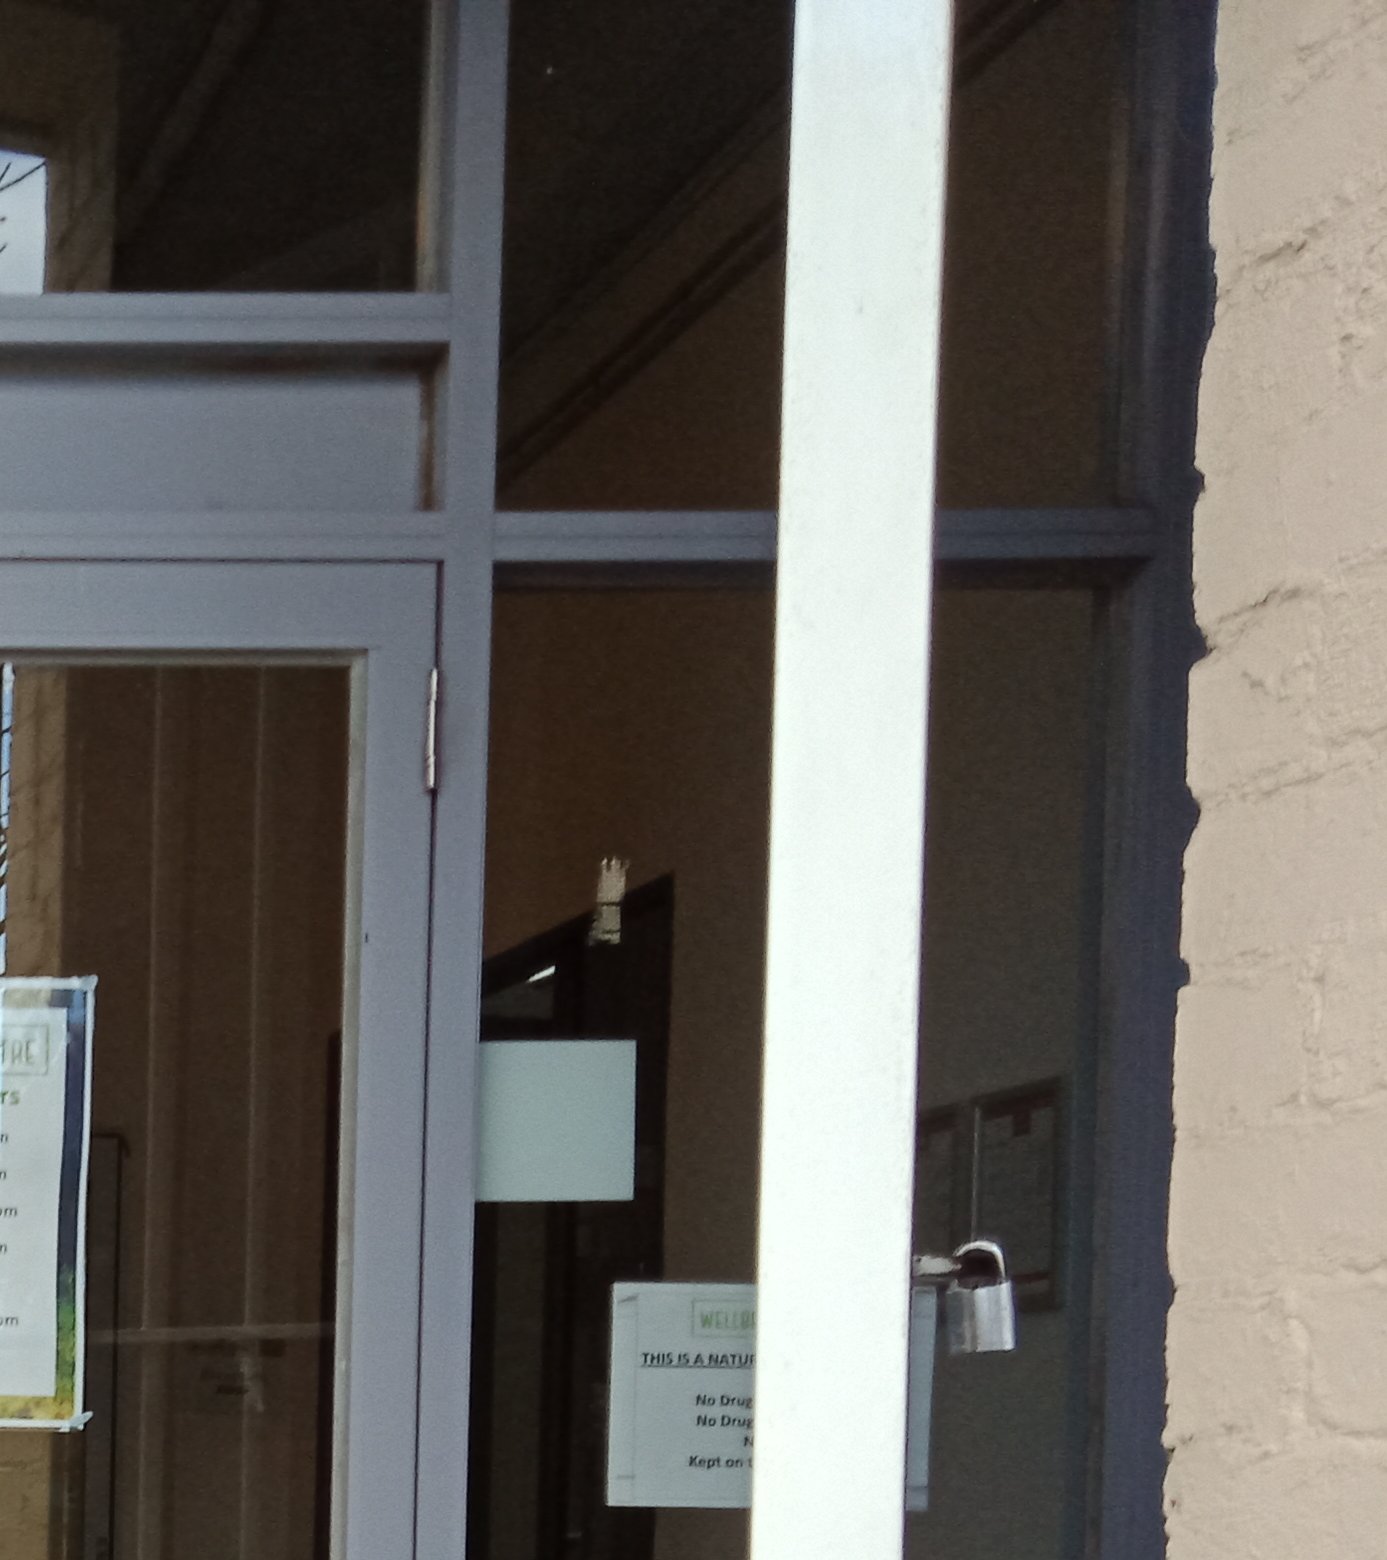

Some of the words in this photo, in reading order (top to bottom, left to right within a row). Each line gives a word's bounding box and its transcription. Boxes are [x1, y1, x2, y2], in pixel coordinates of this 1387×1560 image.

[642, 1352, 673, 1366] THIS
[677, 1352, 690, 1366] IS
[693, 1353, 705, 1366] A
[695, 1393, 716, 1407] No
[696, 1414, 717, 1427] No
[688, 1454, 721, 1470] Kept
[725, 1458, 744, 1468] on
